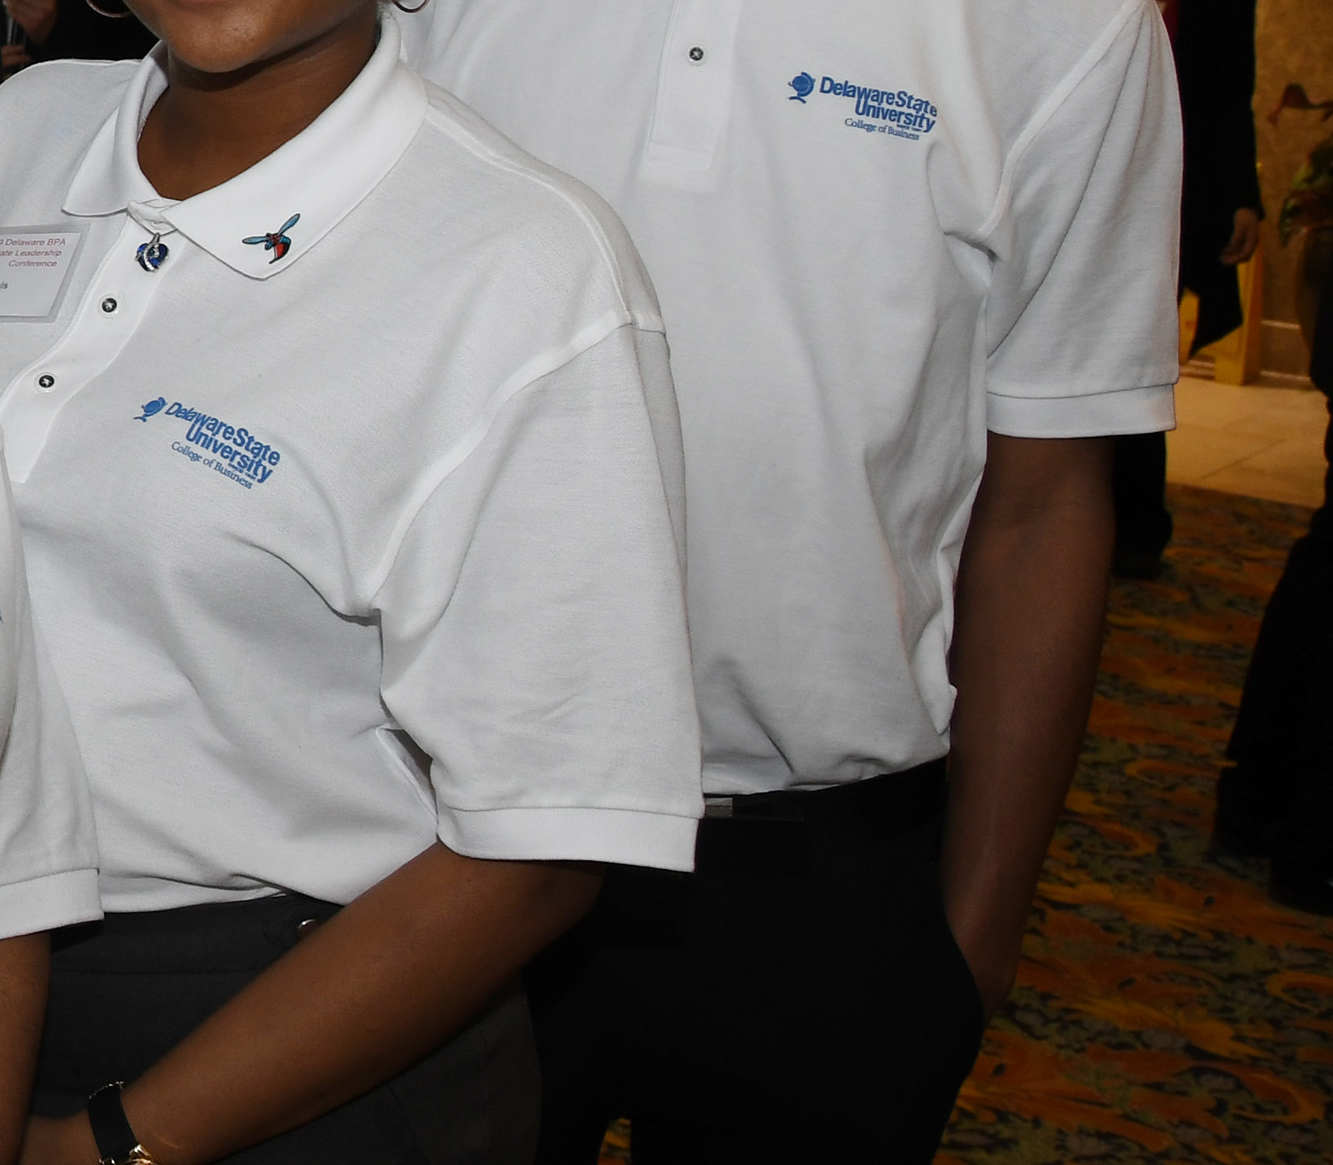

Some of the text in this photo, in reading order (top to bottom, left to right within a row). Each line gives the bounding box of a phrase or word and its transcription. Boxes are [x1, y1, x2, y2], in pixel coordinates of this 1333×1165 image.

[845, 118, 877, 133] College
[878, 124, 889, 133] of
[855, 99, 936, 133] University
[5, 238, 45, 246] Delaware
[47, 238, 66, 246] BPA
[15, 249, 62, 258] Leadership
[171, 441, 203, 462] College
[203, 458, 217, 470] of
[213, 462, 253, 490] Business
[185, 423, 273, 484] University
